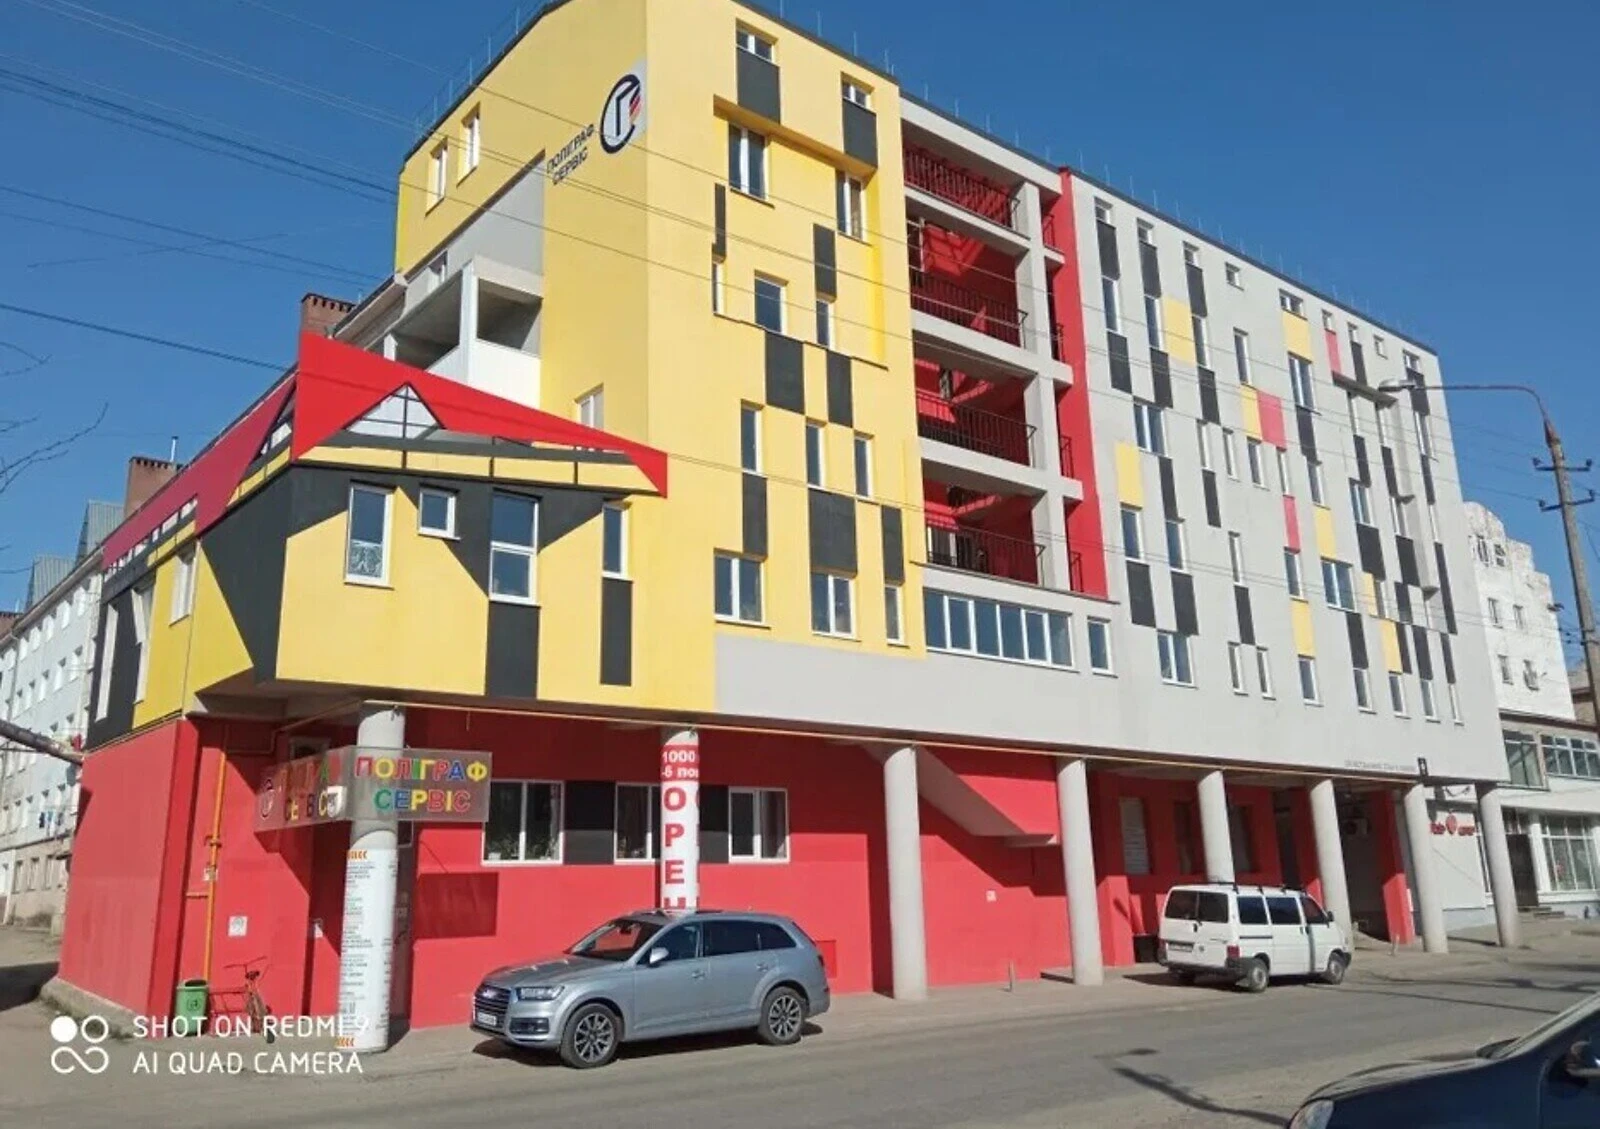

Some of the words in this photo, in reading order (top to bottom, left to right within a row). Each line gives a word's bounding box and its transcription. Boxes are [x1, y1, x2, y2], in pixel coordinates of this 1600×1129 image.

[662, 750, 696, 763] 1000
[354, 756, 488, 782] ПОЛІГРАФ
[374, 788, 471, 812] СЕРВІС
